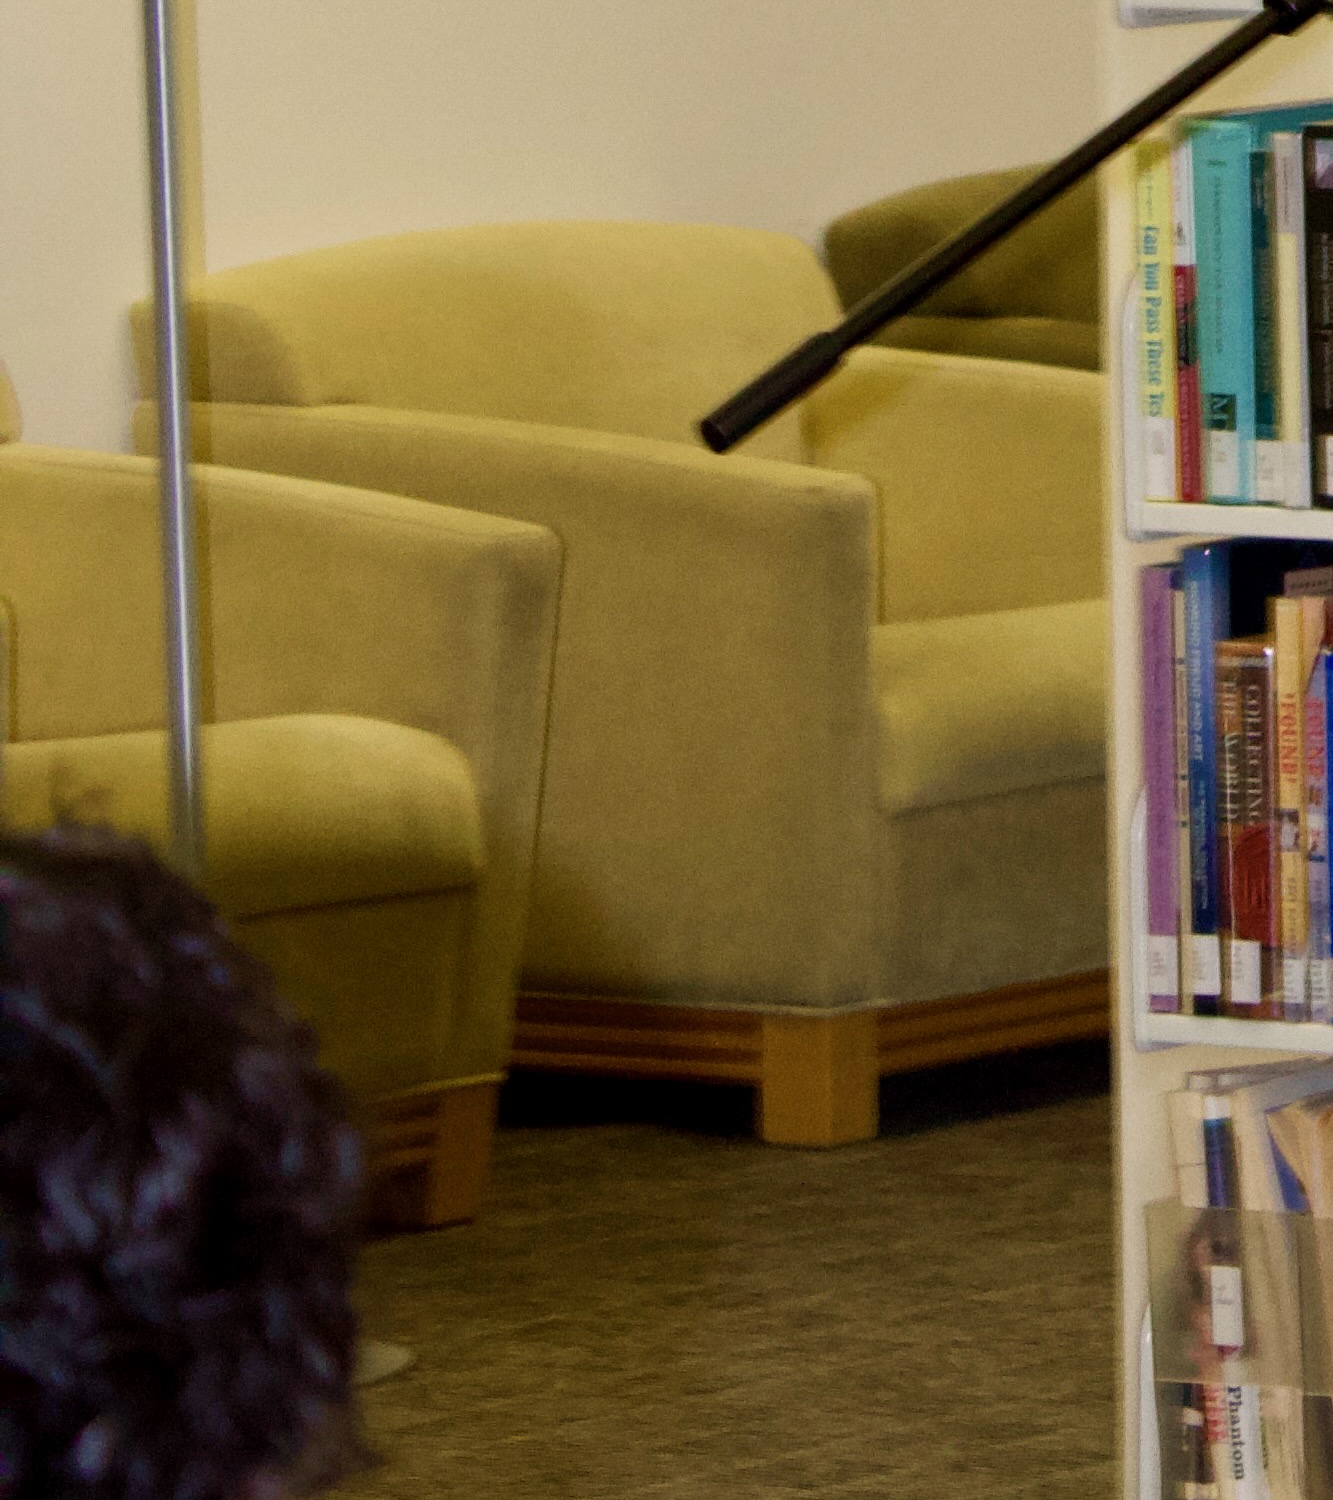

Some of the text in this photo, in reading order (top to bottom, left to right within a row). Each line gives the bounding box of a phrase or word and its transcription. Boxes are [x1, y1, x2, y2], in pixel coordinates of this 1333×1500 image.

[1142, 225, 1159, 256] Can
[1143, 263, 1160, 290] You
[1145, 297, 1162, 334] Pass
[1146, 340, 1164, 386] These
[1189, 649, 1203, 700] FREUD
[1190, 702, 1204, 732] AND
[1191, 734, 1205, 763] ART
[1245, 684, 1265, 828] COLLECTING
[1229, 733, 1247, 821] WORLD
[1227, 1385, 1247, 1481] Phantom
